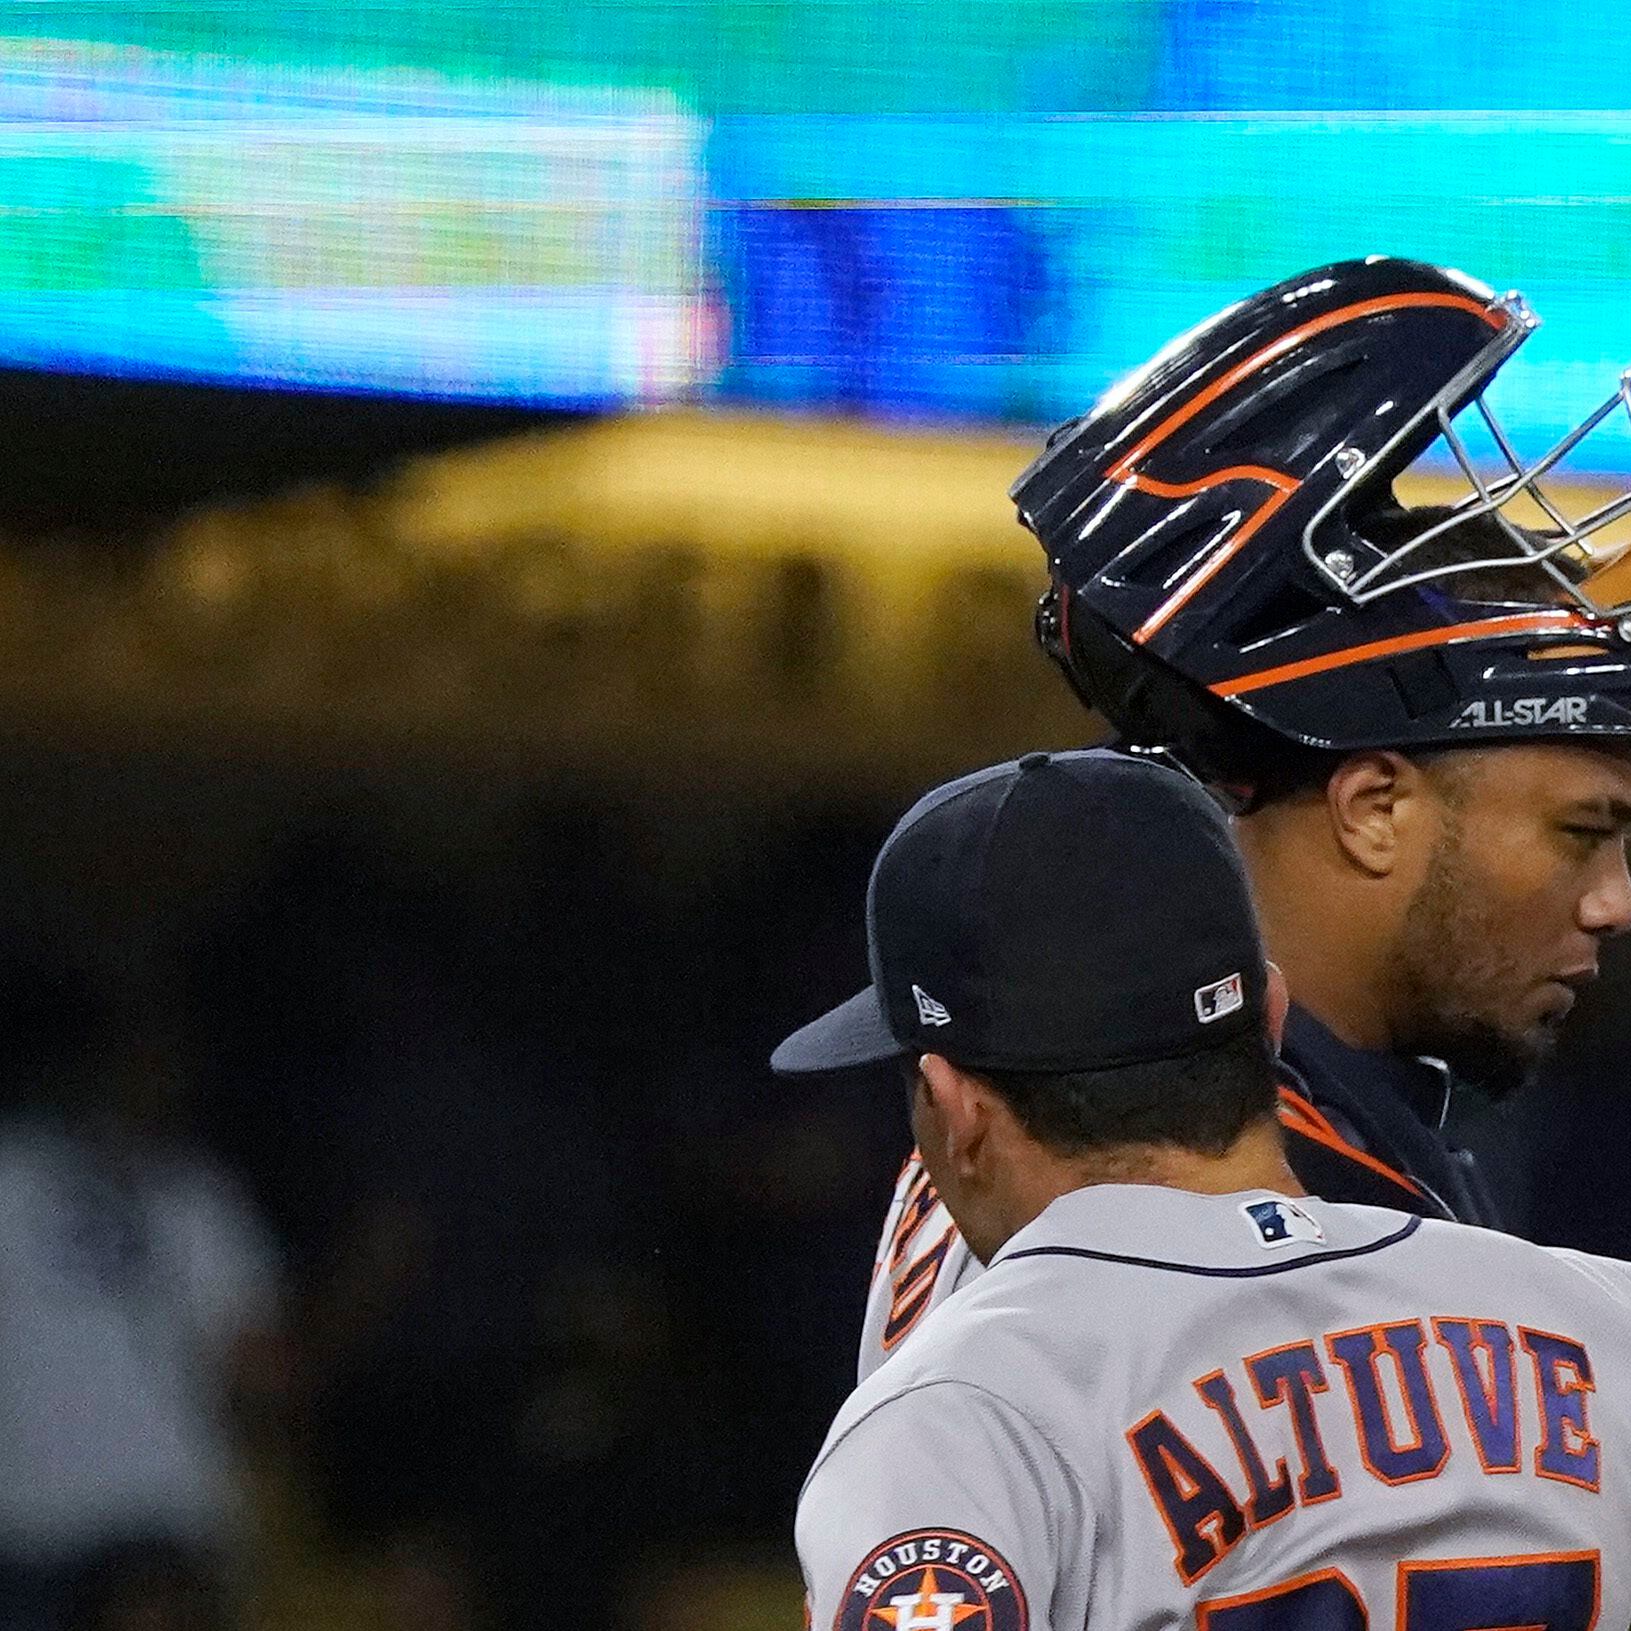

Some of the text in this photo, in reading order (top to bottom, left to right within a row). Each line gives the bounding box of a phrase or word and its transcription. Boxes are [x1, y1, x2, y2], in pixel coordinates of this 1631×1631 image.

[1450, 697, 1588, 727] ALL-STAR
[1126, 1316, 1600, 1587] ALTUVE
[853, 1539, 1009, 1597] HOUSTON
